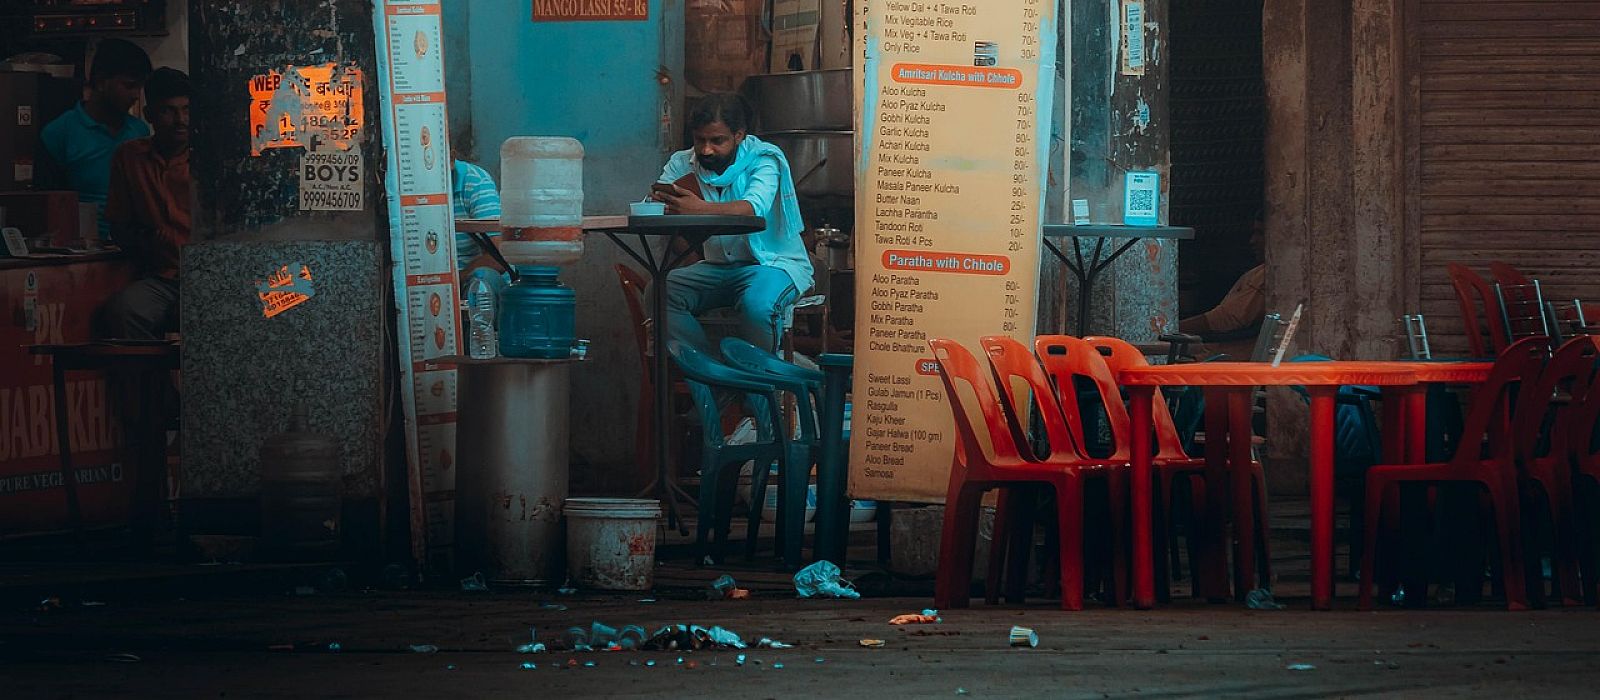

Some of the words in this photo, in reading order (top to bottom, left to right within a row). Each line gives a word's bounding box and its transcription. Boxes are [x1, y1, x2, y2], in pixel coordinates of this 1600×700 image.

[534, 0, 577, 16] MANGO
[580, 0, 611, 16] LASSI
[886, 1, 909, 11] Yellow
[911, 2, 924, 12] Dal
[940, 4, 959, 14] Tawa
[962, 5, 977, 15] Roti
[1024, 8, 1038, 18] 70/-
[885, 15, 898, 24] Mix
[936, 17, 953, 27] Rice
[1023, 22, 1037, 31] 70/-
[885, 29, 897, 38] Mix
[900, 29, 914, 41] Veg
[931, 30, 949, 41] Tawa
[951, 31, 967, 41] Roti
[1022, 36, 1037, 45] 70/-
[884, 42, 901, 53] Only
[904, 43, 920, 53] Rice
[1021, 49, 1036, 59] 30/-
[899, 68, 936, 80] Amritsari
[939, 70, 965, 81] Kulcha
[968, 71, 984, 82] with
[882, 86, 898, 95] Aloo
[900, 87, 926, 97] Kulcha
[1018, 93, 1033, 102] 60/-
[881, 100, 898, 109] Aloo
[899, 101, 918, 111] Pyaz
[920, 102, 946, 112] Kulcha
[1017, 106, 1032, 115] 70/-
[880, 113, 902, 122] Gobhi
[904, 114, 930, 124] Kulcha
[1017, 120, 1031, 129] 70/-
[880, 126, 901, 137] Garlic
[904, 127, 929, 138] Kulcha
[1015, 133, 1030, 143] 80/-
[879, 139, 902, 150] Achari
[904, 140, 930, 151] Kulcha
[1014, 146, 1029, 156] 80/-
[878, 152, 891, 163] Mix
[893, 154, 919, 165] Kulcha
[1014, 160, 1028, 170] 80/-
[304, 165, 360, 181] BOYS
[878, 166, 904, 177] Paneer
[906, 167, 932, 179] Kulcha
[1013, 174, 1028, 184] 90/-
[877, 180, 904, 191] Masala
[905, 181, 932, 193] Paneer
[934, 183, 959, 194] Kulcha
[1012, 187, 1027, 197] 90/-
[304, 190, 361, 208] 9999456709
[876, 193, 899, 204] Butter
[900, 194, 920, 205] Naan
[1011, 201, 1025, 211] 25/-
[875, 207, 902, 218] Lachha
[904, 208, 938, 220] Parantha
[1010, 214, 1024, 224] 25/-
[875, 220, 907, 231] Tandoori
[909, 221, 923, 232] Roti
[1010, 228, 1024, 238] 10/-
[875, 233, 894, 244] Tawa
[896, 235, 910, 246] Roti
[912, 236, 917, 246] 4
[919, 236, 933, 247] Pcs
[1009, 241, 1023, 251] 20/-
[889, 253, 932, 268] Paratha
[935, 255, 959, 269] with
[963, 257, 1003, 272] Chhole
[872, 273, 889, 284] Aloo
[891, 274, 919, 286] Paratha
[1006, 280, 1020, 290] 60/-
[872, 287, 888, 297] Aloo
[890, 288, 908, 300] Pyaz
[910, 289, 938, 300] Paratha
[1005, 294, 1019, 304] 70/-
[871, 301, 893, 311] Gobhi
[894, 302, 923, 313] Paratha
[1004, 308, 1018, 318] 70/-
[870, 314, 884, 324] Mix
[885, 315, 913, 326] Paratha
[1003, 321, 1017, 331] 80/-
[870, 328, 897, 338] Paneer
[899, 329, 926, 340] Paratha
[870, 340, 890, 351] Chole
[868, 373, 890, 383] Sweet
[892, 375, 911, 384] Lassi
[868, 386, 889, 396] Gulab
[890, 388, 915, 398] Jamun
[925, 389, 942, 400] Pcs)
[867, 400, 898, 411] Rasgulla
[867, 413, 883, 424] Kaju
[884, 414, 906, 424] Kheer
[866, 427, 885, 439] Gajar
[887, 428, 909, 438] Halwa
[910, 428, 927, 440] (100
[865, 441, 891, 450] Paneer
[893, 442, 914, 452] Bread
[865, 454, 881, 464] Aloo
[883, 455, 904, 465] Bread
[32, 467, 112, 487] VEGEARIAN
[864, 468, 894, 478] Samosa
